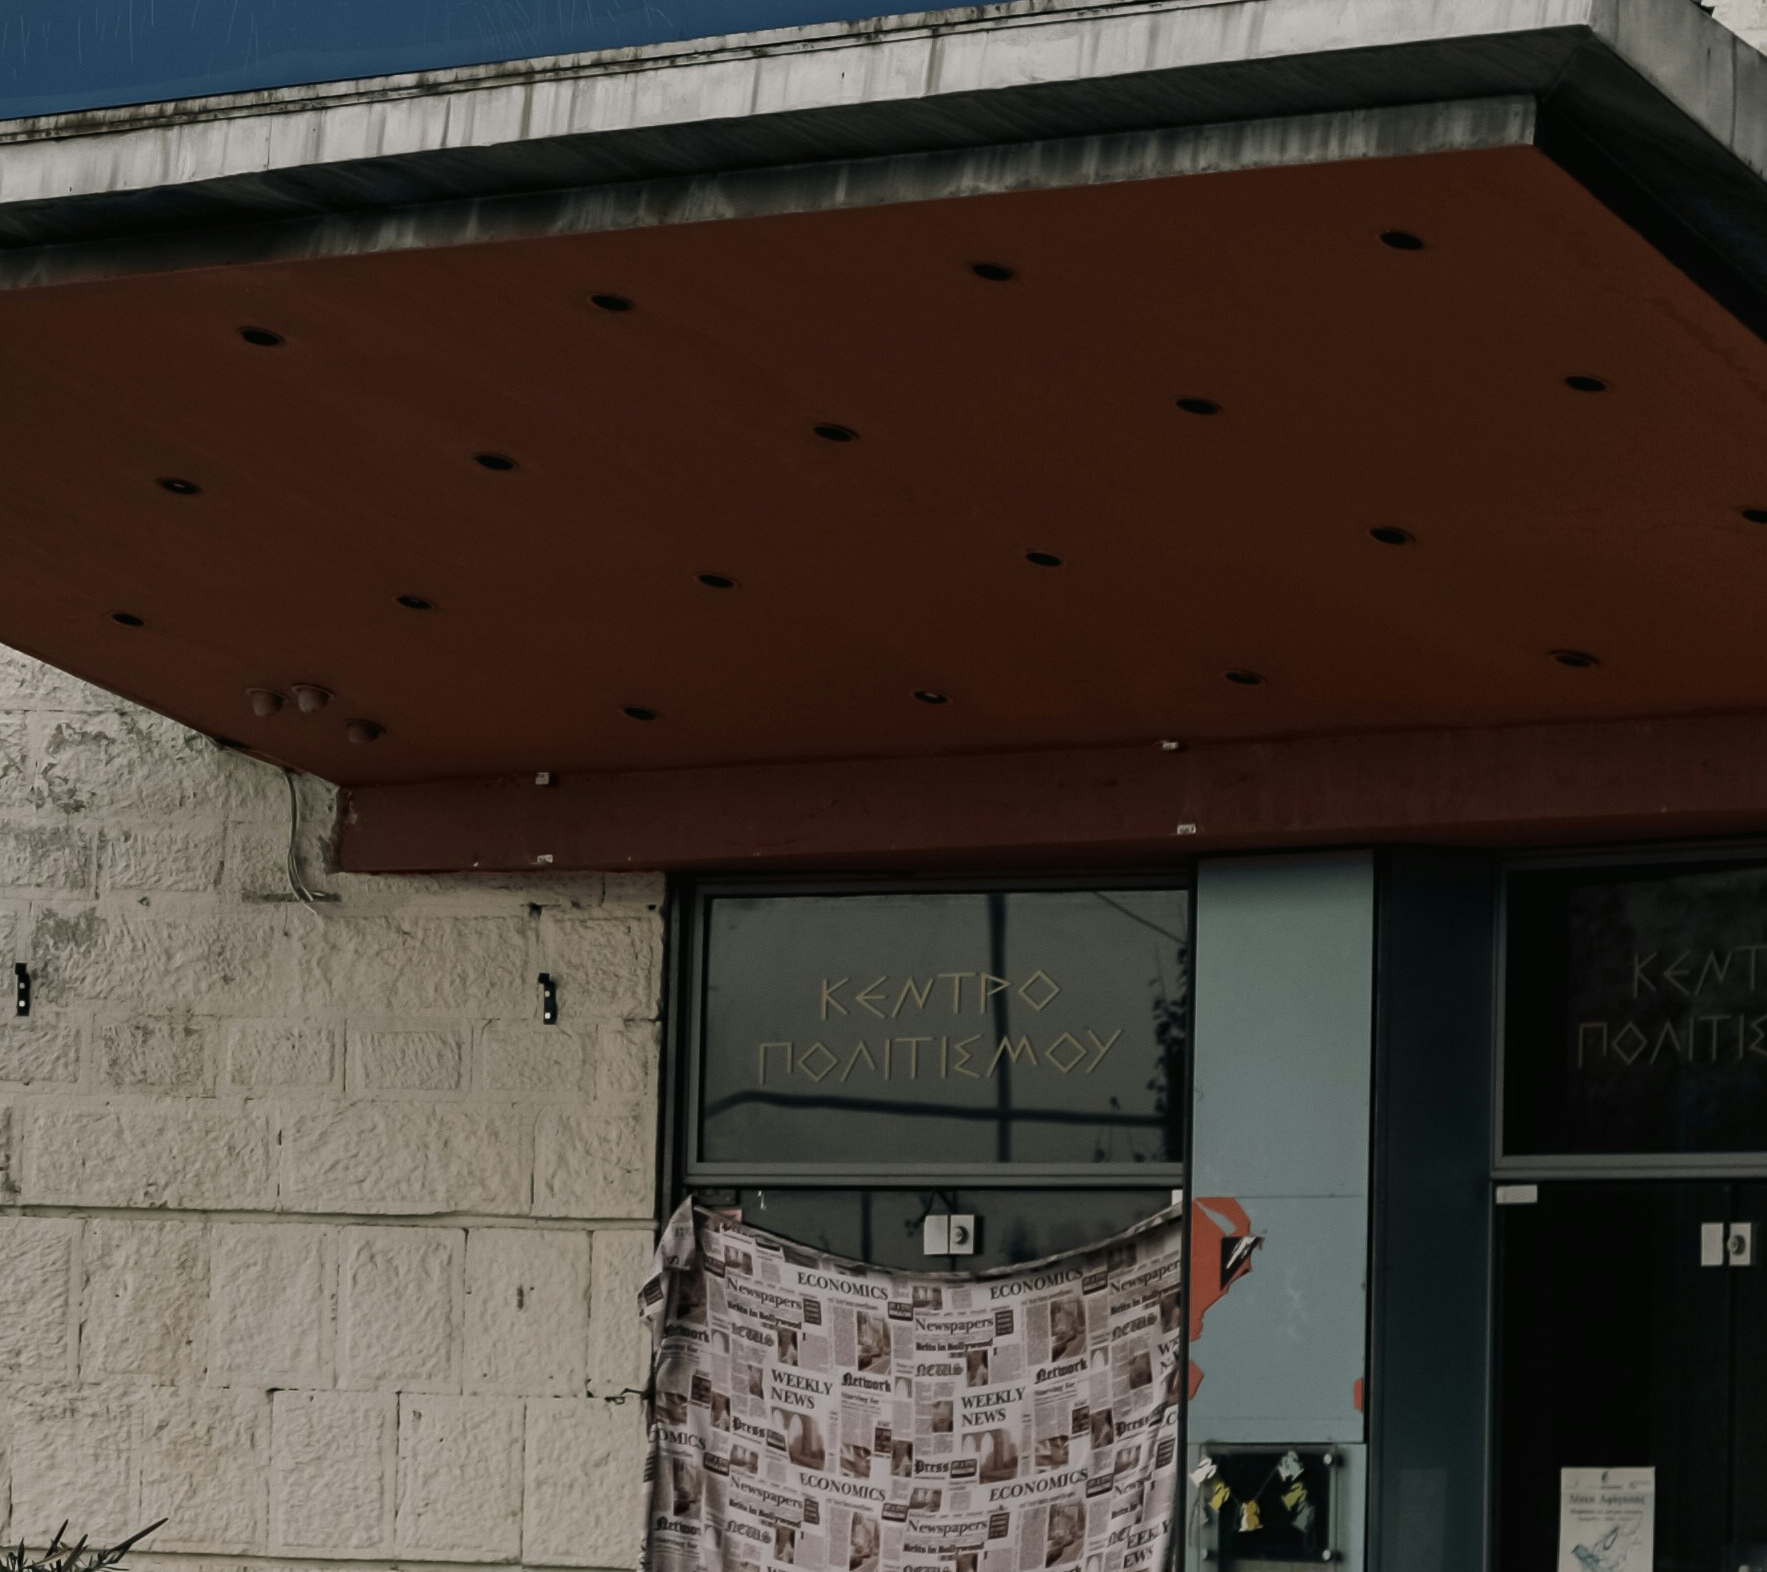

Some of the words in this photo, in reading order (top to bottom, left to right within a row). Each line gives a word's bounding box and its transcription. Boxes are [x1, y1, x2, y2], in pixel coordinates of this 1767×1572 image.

[821, 970, 1061, 1022] ΚΕΝΤΡΟ
[759, 1028, 1123, 1086] ΠΟΛΙΤΙΣΜΟΥ
[727, 1277, 803, 1311] Newspapers
[797, 1272, 889, 1300] ECONOMICS
[990, 1267, 1083, 1300] ECONOMICS
[915, 1317, 993, 1335] Newspapers
[771, 1369, 833, 1395] WEEKLY
[841, 1372, 891, 1393] Network
[770, 1386, 815, 1409] NEWS
[961, 1386, 1025, 1409] WEEKLY
[961, 1408, 1006, 1427] NEWS
[915, 1459, 950, 1475] Press
[731, 1476, 803, 1508] Newspapers
[799, 1472, 885, 1501] ECONOMICS
[989, 1469, 1089, 1502] ECONOMICS
[908, 1519, 989, 1537] Newspapers
